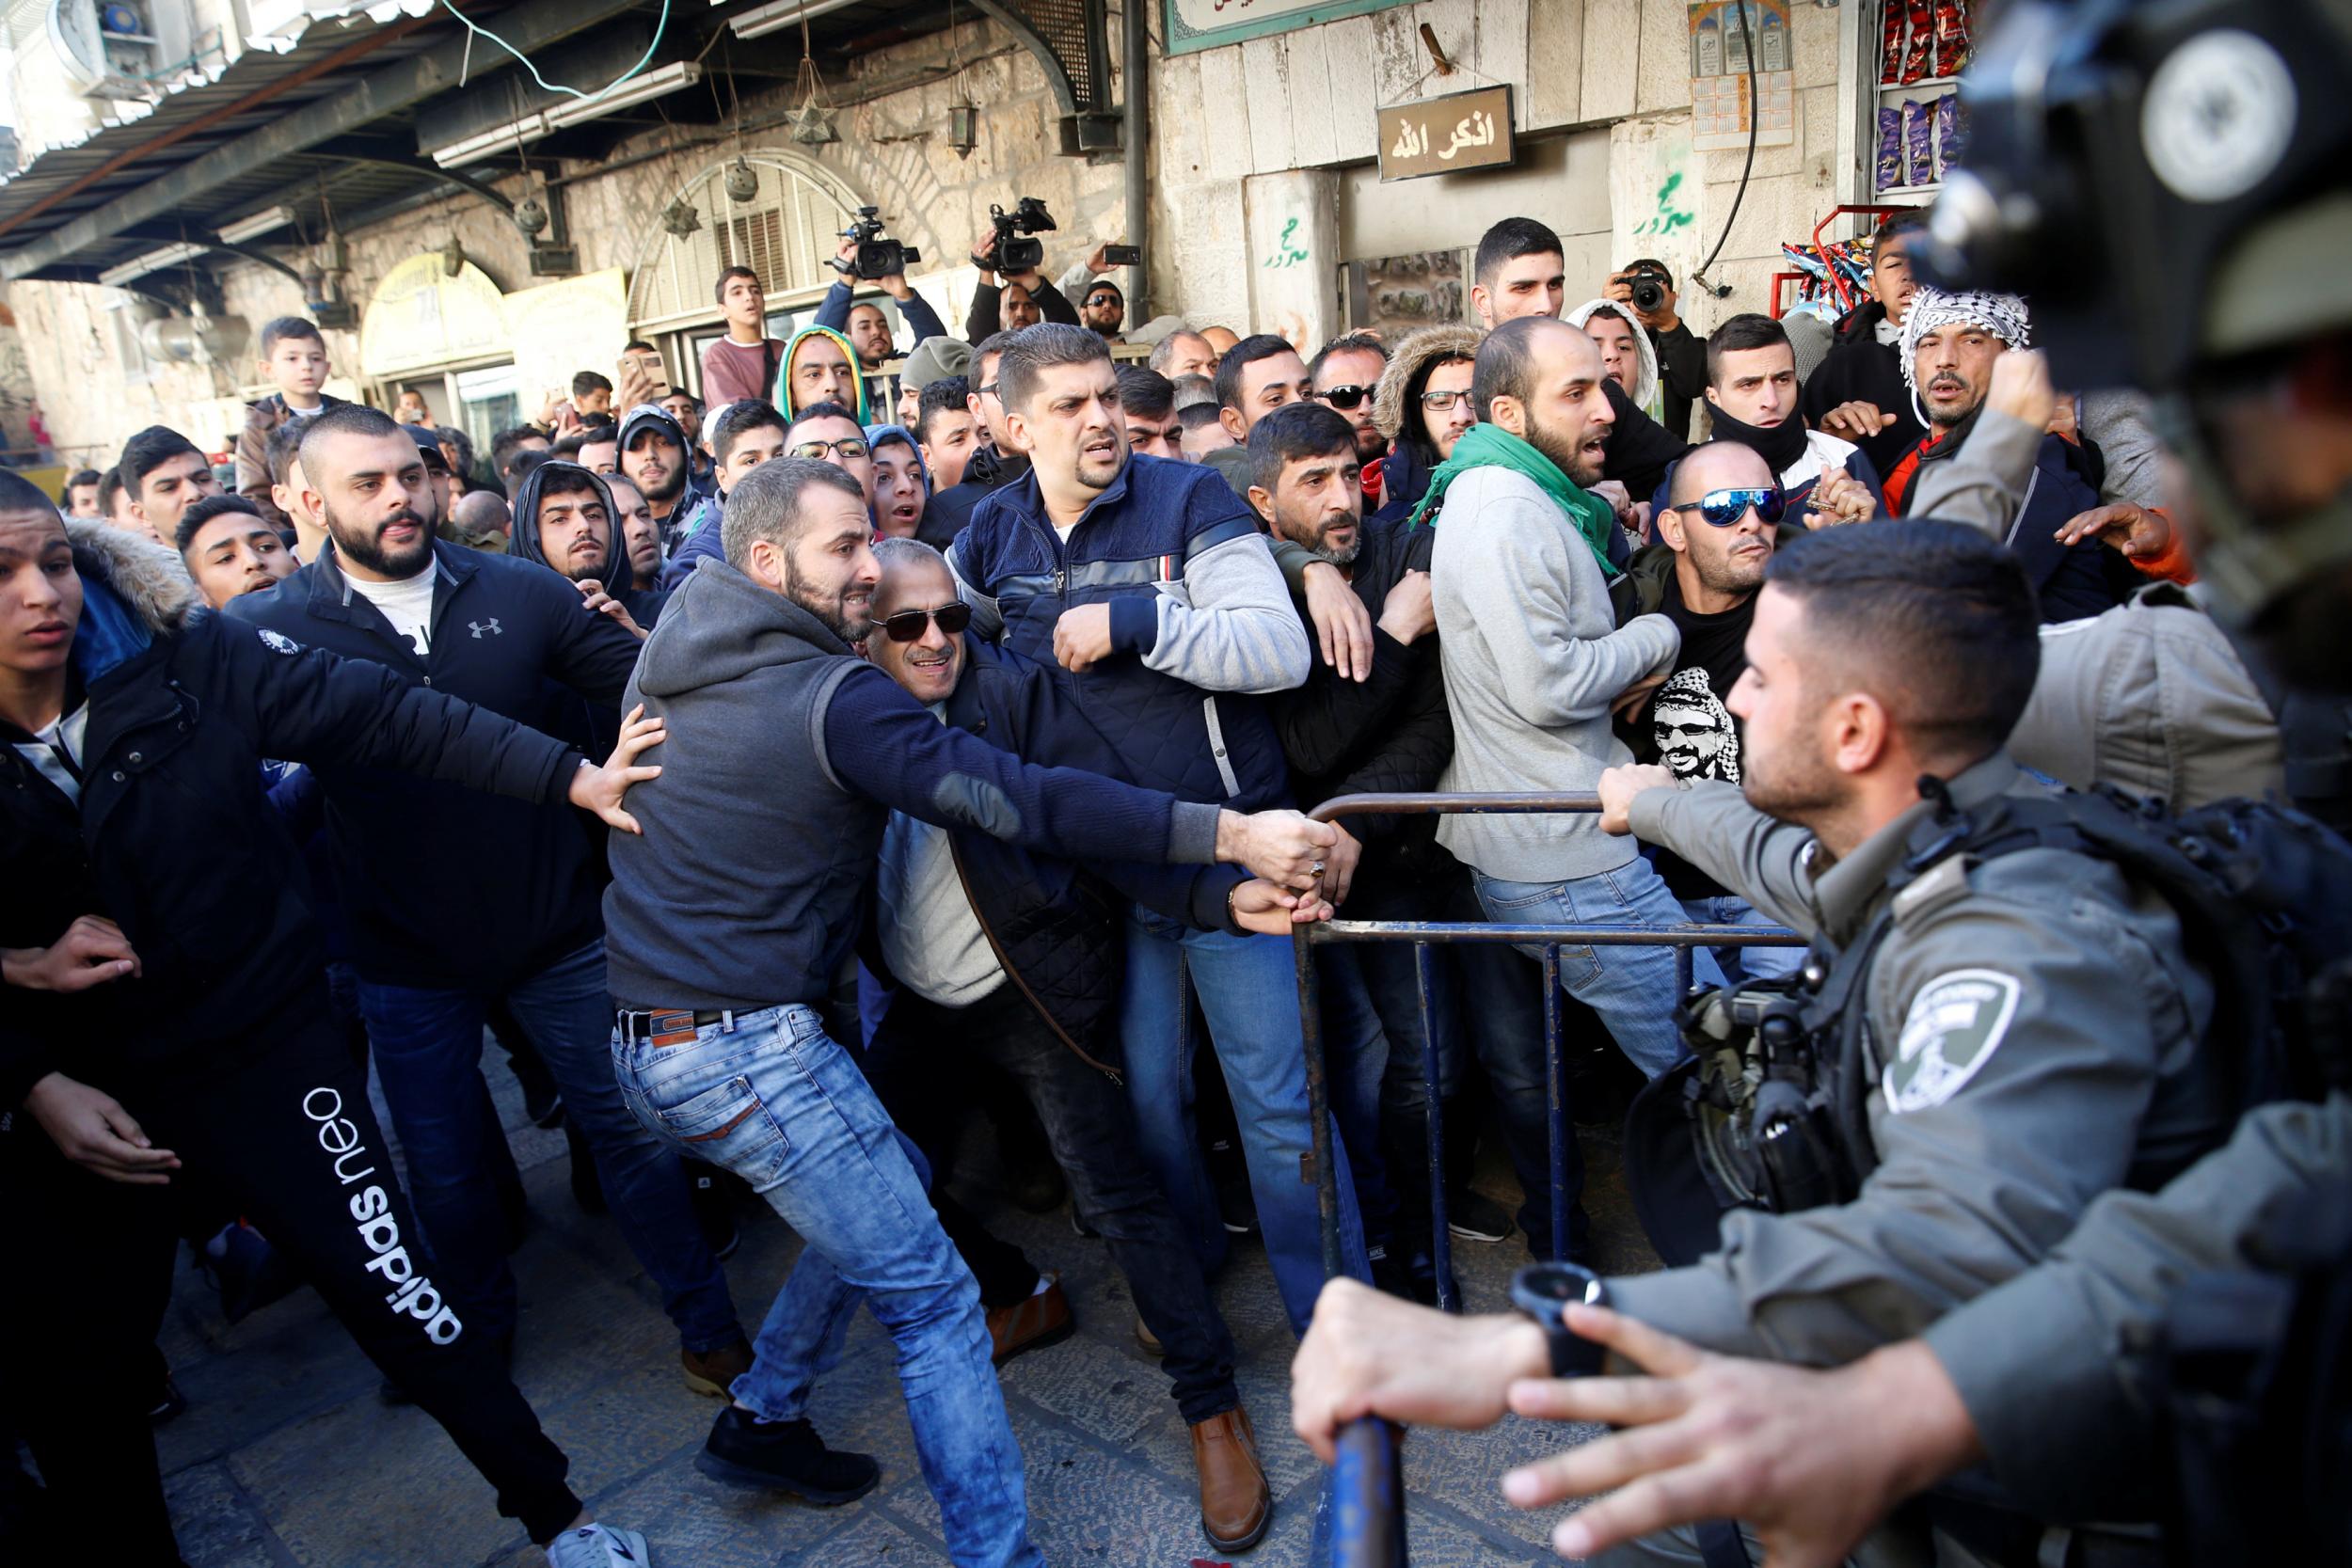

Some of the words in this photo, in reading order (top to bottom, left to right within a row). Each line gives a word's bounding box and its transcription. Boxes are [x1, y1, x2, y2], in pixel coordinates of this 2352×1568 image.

[1392, 119, 1428, 158] الله
[1438, 110, 1494, 159] اذكر
[303, 1087, 374, 1185] neo
[350, 1185, 462, 1345] adidas
